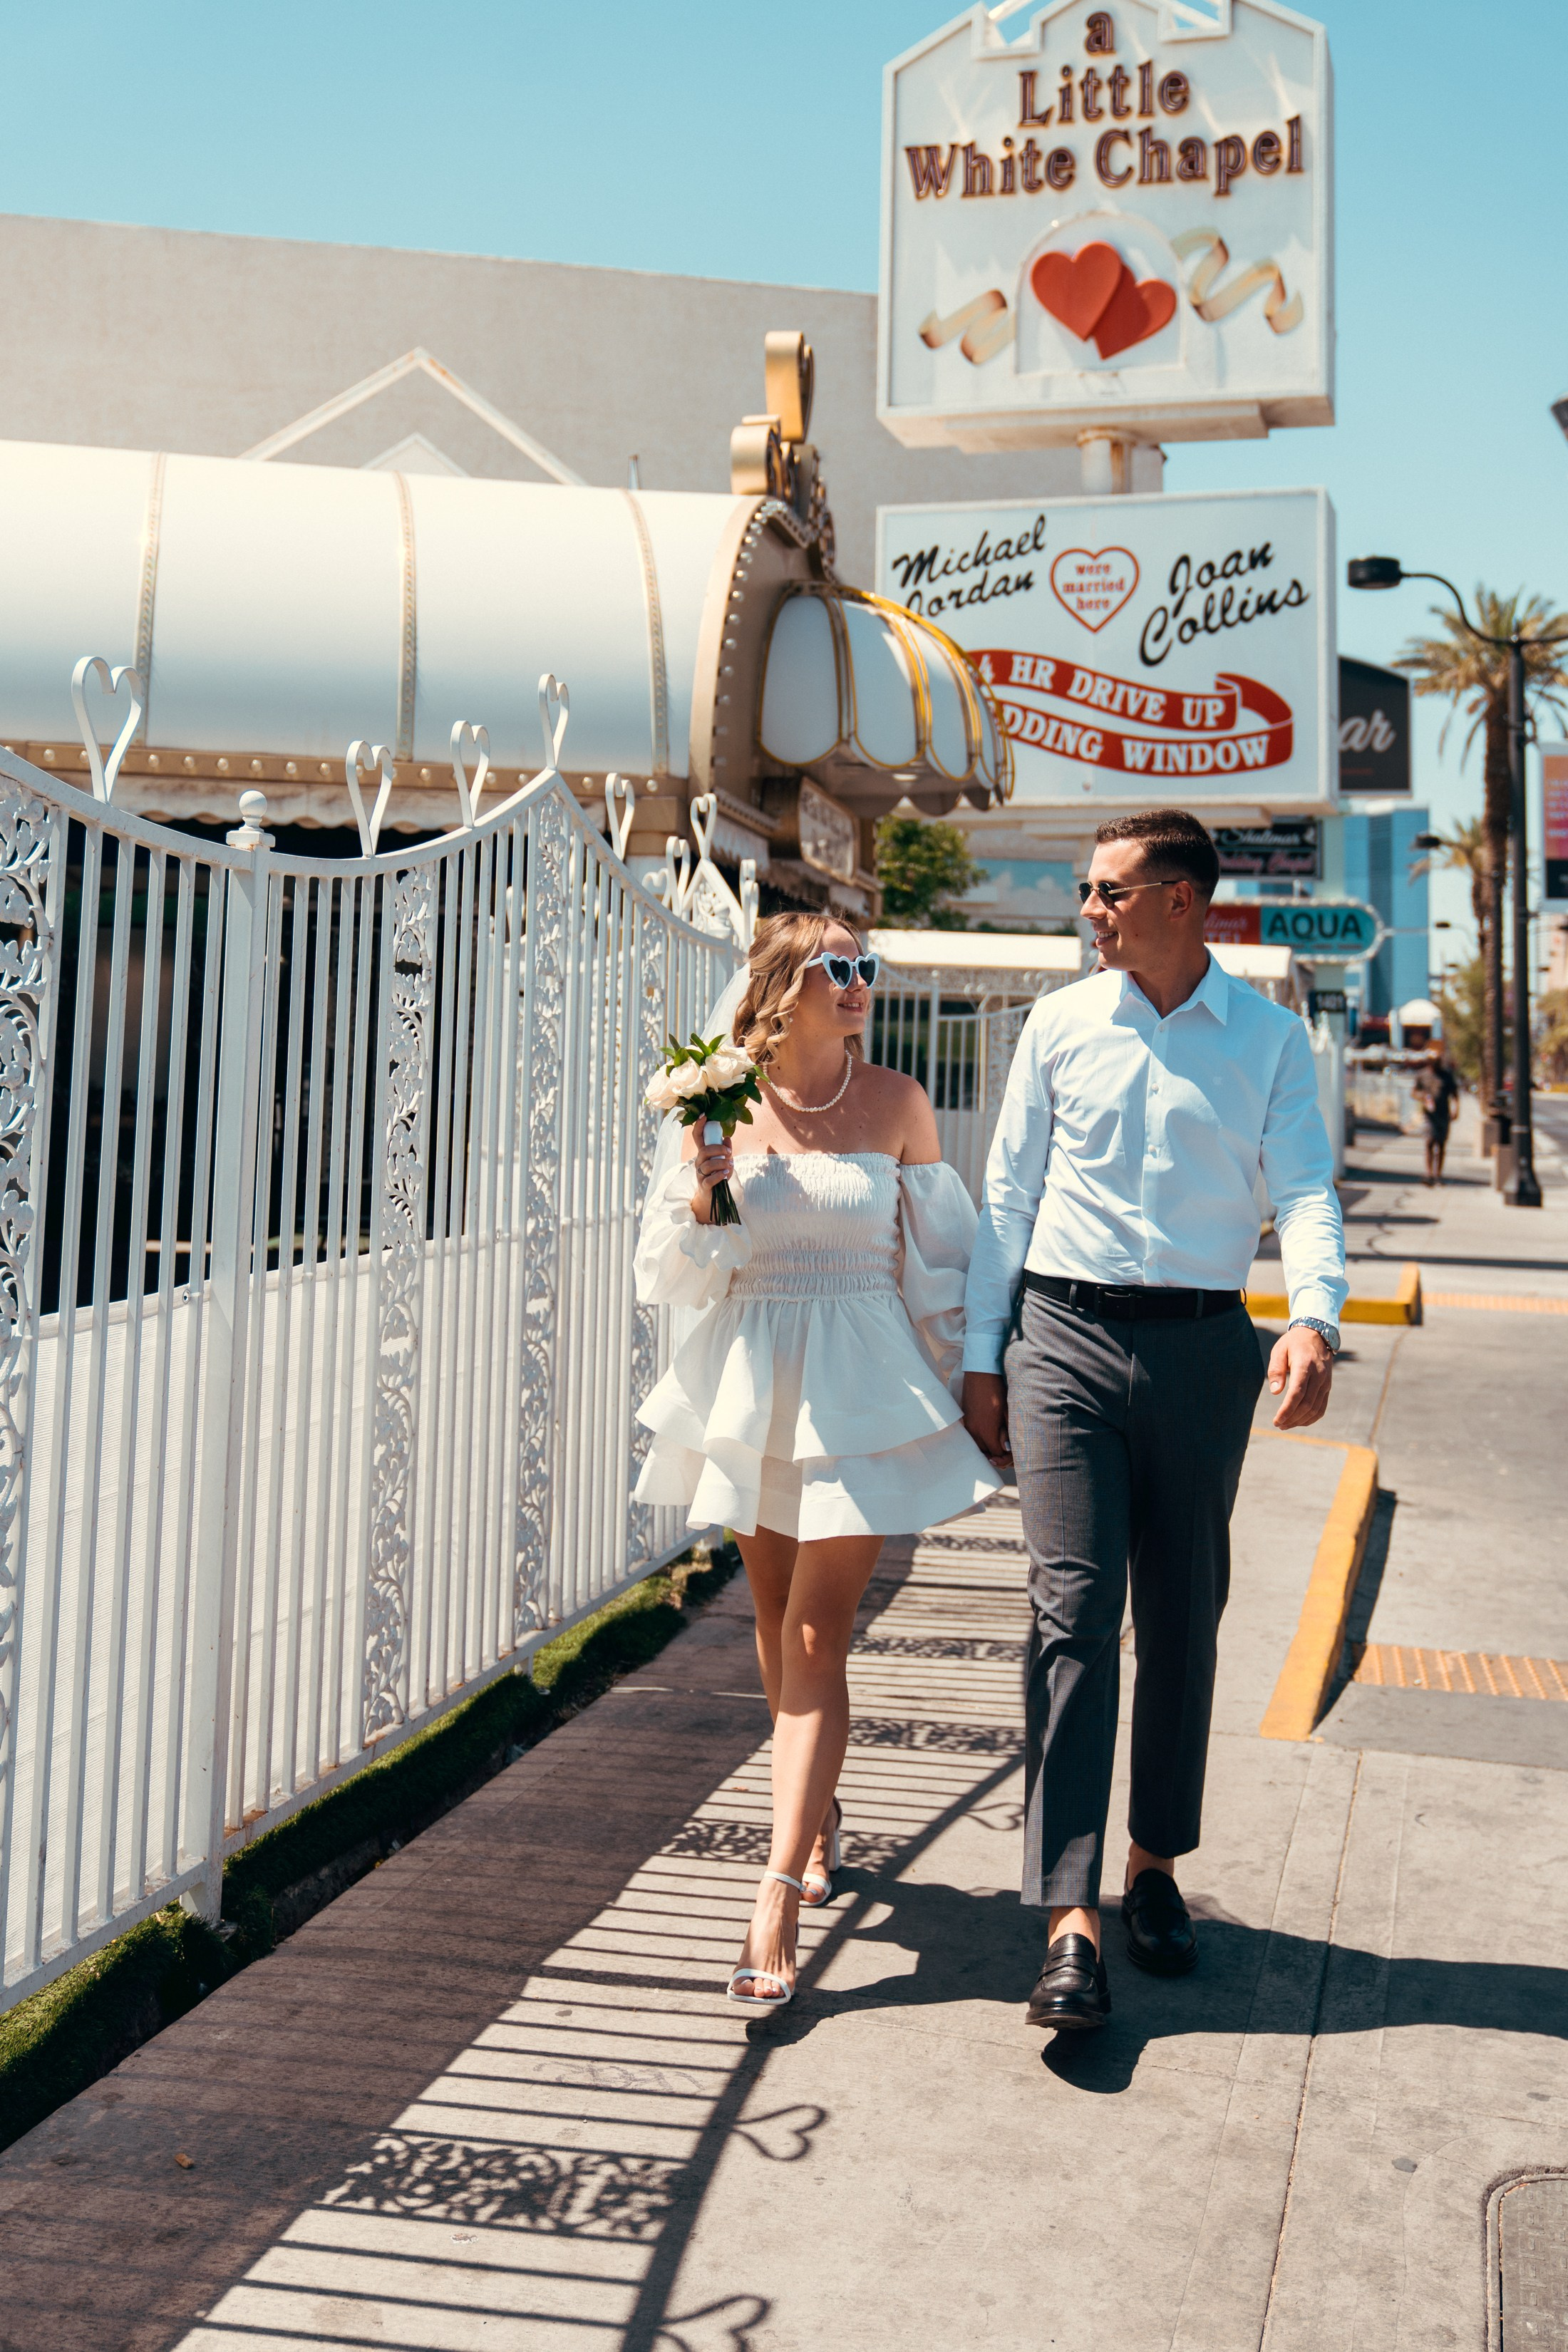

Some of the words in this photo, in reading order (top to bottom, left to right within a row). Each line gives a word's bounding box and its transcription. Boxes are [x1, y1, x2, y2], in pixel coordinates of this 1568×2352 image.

[1085, 11, 1116, 55] a
[1018, 59, 1190, 128] Little
[904, 136, 1076, 200] White
[1093, 114, 1304, 197] Chapel
[892, 513, 1046, 588] Michael
[1076, 563, 1110, 575] were
[1168, 541, 1274, 619] Joan
[906, 569, 1035, 618] Jordan
[1063, 577, 1125, 594] married
[1076, 596, 1110, 611] here
[1139, 578, 1310, 667] Collins
[1009, 654, 1056, 690] HR
[1066, 669, 1166, 723] DRIVE
[1182, 697, 1225, 728] UP
[1000, 703, 1104, 762] DDING
[1121, 734, 1269, 773] WINDOW
[1339, 708, 1396, 753] ar
[1267, 912, 1363, 942] AQUA
